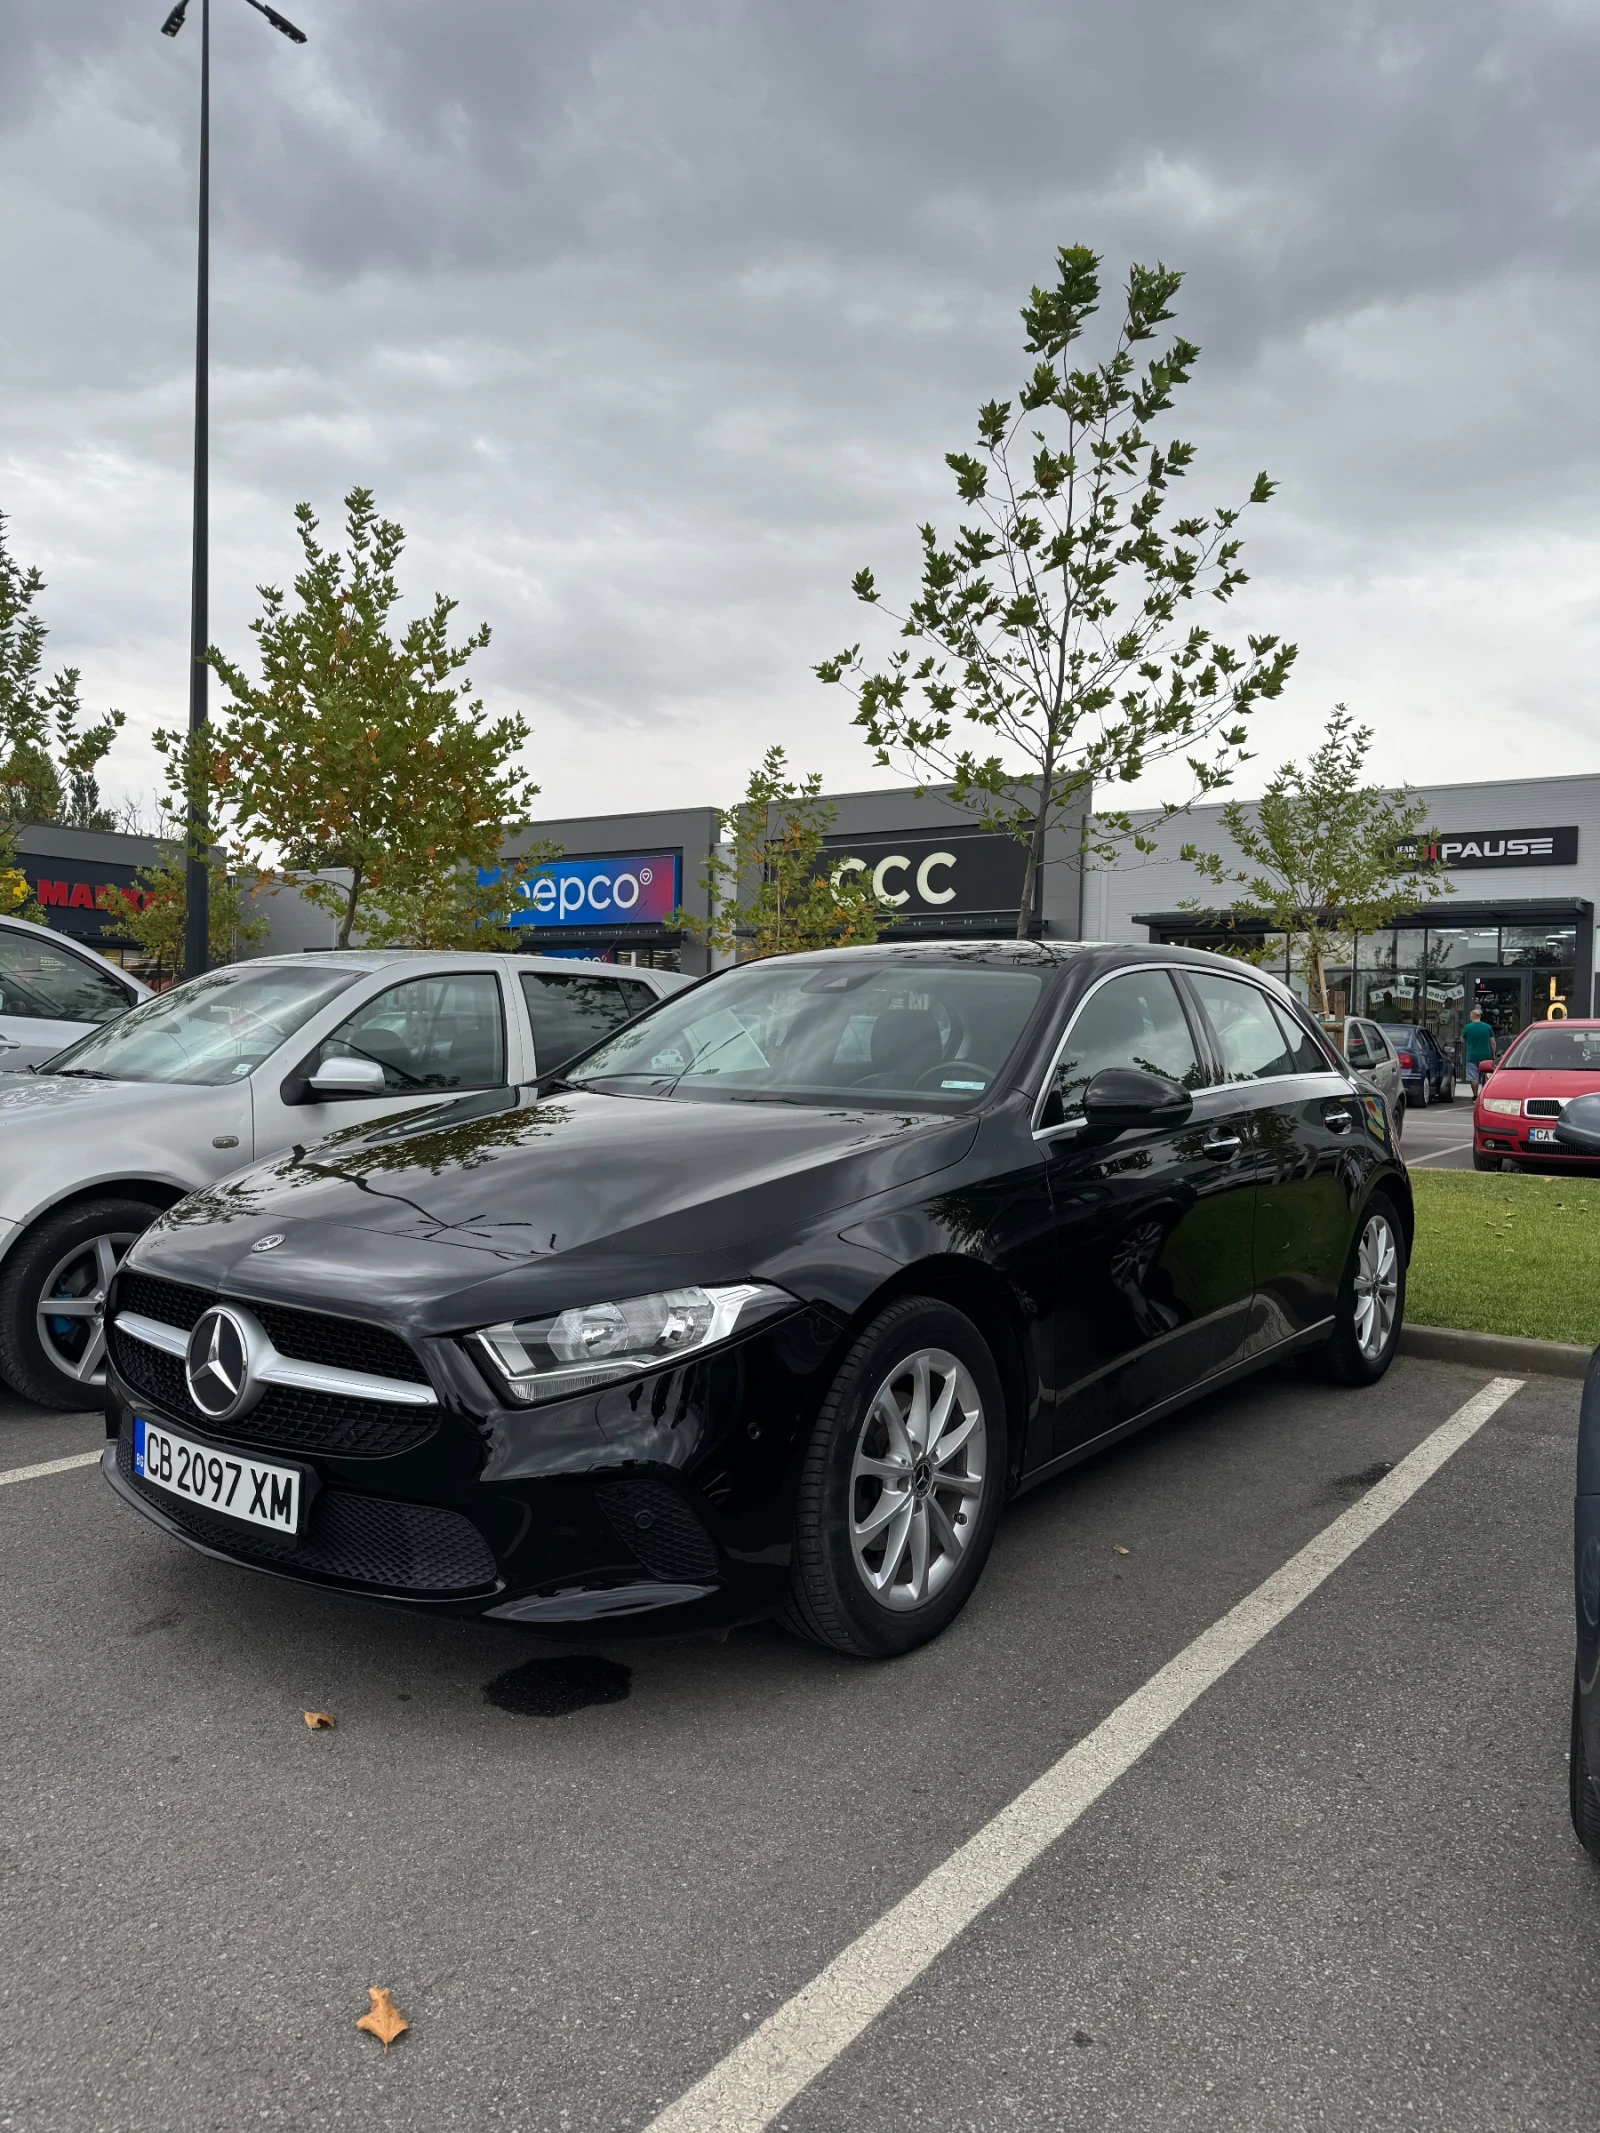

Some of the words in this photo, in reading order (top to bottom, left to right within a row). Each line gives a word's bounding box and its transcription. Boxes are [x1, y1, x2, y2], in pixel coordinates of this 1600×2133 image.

[1441, 838, 1553, 858] PAUSE
[830, 852, 957, 907] CCC
[147, 1432, 173, 1483] CB
[177, 1446, 242, 1508] 2097
[249, 1468, 293, 1525] XM
